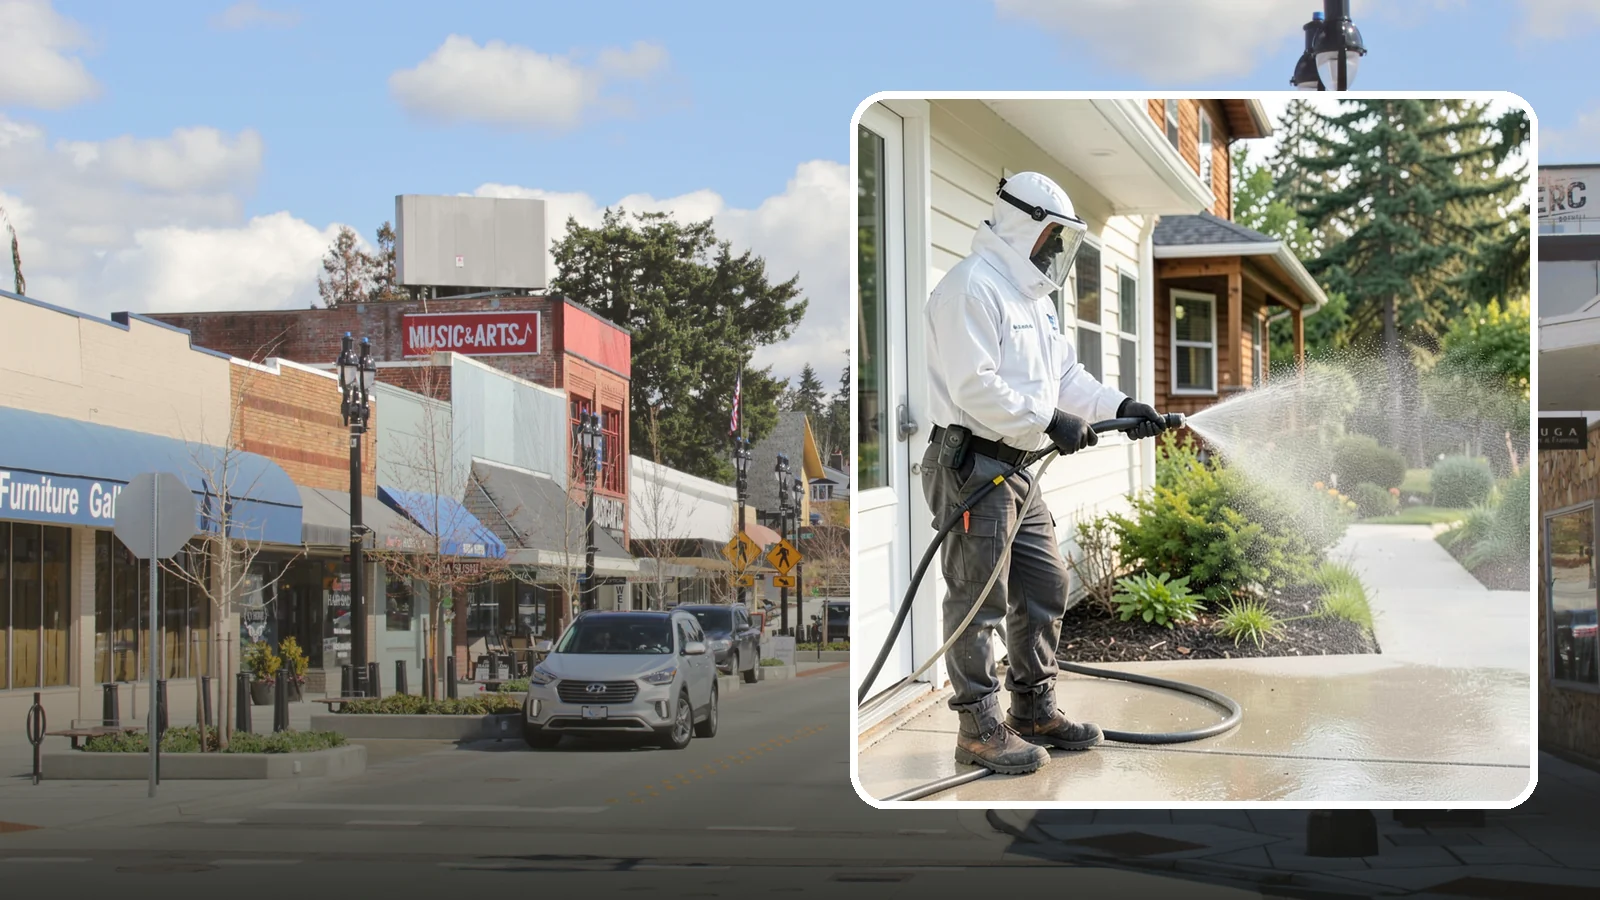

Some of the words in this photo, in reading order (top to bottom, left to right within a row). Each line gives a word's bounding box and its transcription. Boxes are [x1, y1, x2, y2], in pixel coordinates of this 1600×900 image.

[1540, 427, 1578, 437] UGA
[0, 471, 79, 515] Furniture
[89, 482, 122, 519] Gal
[453, 563, 480, 574] SUSHI
